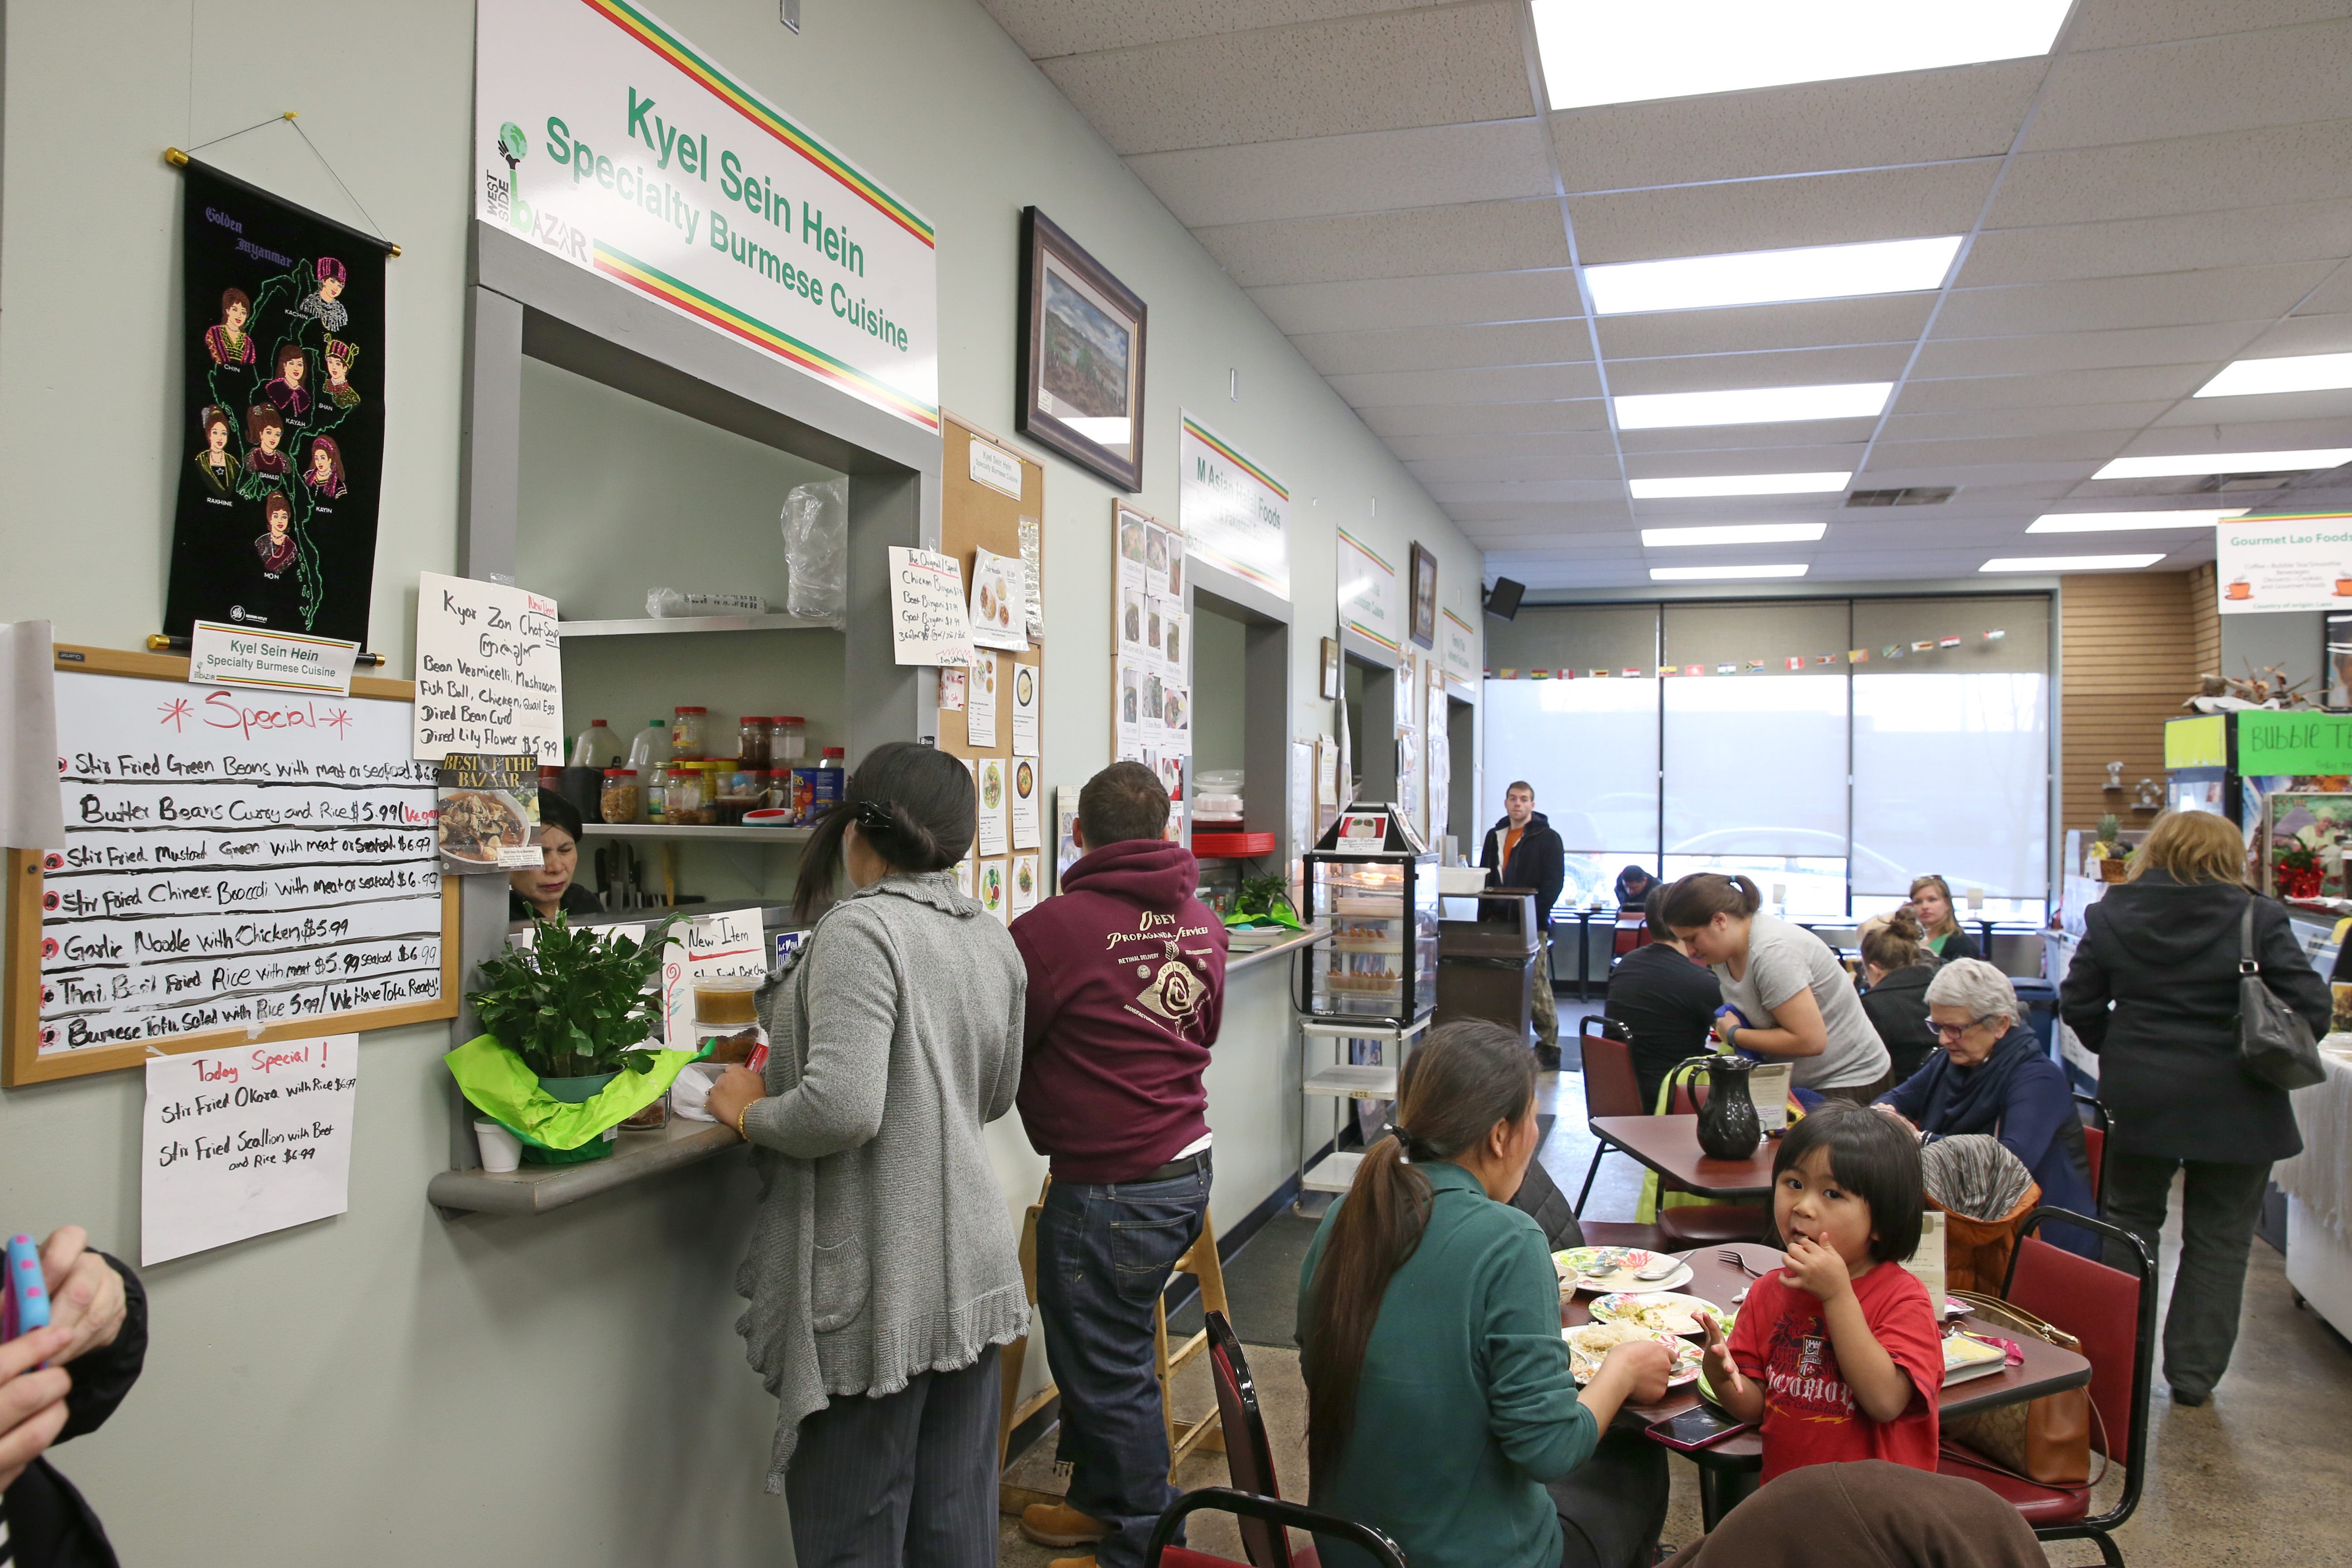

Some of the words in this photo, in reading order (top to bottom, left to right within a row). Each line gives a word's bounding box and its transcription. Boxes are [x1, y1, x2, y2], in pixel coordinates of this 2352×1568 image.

[487, 169, 498, 216] WEST
[628, 86, 707, 183] Kyel
[720, 150, 791, 234] Sein
[803, 202, 864, 278] Hein
[498, 179, 509, 222] SIDE
[206, 206, 242, 233] Golden
[546, 116, 700, 244] Specialty
[710, 210, 823, 306] Burmese
[830, 282, 908, 352] Cuisine
[235, 238, 293, 268] Myanmar
[284, 308, 309, 320] KACHIN
[224, 364, 240, 372] CHIN
[286, 418, 305, 426] KAYAH
[260, 472, 279, 481] BAMAR
[207, 498, 233, 507] RAKHINE
[1197, 456, 1205, 483] M
[1209, 465, 1233, 497] Asian
[1236, 483, 1256, 514] Halal
[1259, 497, 1280, 530] Foods
[2231, 535, 2287, 545] Gourmet
[2290, 534, 2313, 543] Lao
[907, 550, 918, 564] The
[528, 595, 541, 612] New
[541, 600, 555, 617] Item
[922, 595, 944, 612] Biryani
[488, 606, 512, 630] Zan
[519, 614, 543, 637] Chat
[922, 612, 944, 627] Biryani
[207, 654, 254, 670] Specialty
[257, 660, 299, 673] Burmese
[302, 665, 335, 677] Cuisine
[230, 640, 256, 655] Kyel
[261, 644, 286, 657] Sein
[290, 647, 318, 662] Hein
[423, 655, 452, 672] Bean
[516, 672, 557, 694] Mushroom
[421, 680, 443, 696] Fish
[523, 698, 541, 711] Quail
[543, 700, 555, 715] Egg
[204, 691, 316, 740] Special
[421, 706, 456, 722] Dired
[461, 706, 488, 722] Bean
[489, 709, 512, 725] Curd
[421, 728, 456, 744] Dired
[459, 729, 480, 749] Lily
[485, 731, 517, 746] Flower
[521, 735, 558, 758] $5.99
[76, 752, 111, 775] Stir
[118, 754, 160, 775] Fried
[167, 754, 213, 772] Green
[224, 756, 271, 776] Beans
[316, 763, 346, 778] meat
[350, 766, 360, 778] or
[443, 755, 480, 770] BEST
[502, 757, 537, 771] THE
[80, 794, 149, 823] Butter
[159, 796, 223, 821] Beans
[285, 801, 312, 818] and
[320, 802, 348, 818] Rice
[68, 846, 102, 867] Stir
[107, 847, 147, 866] Fried
[219, 842, 260, 856] Green
[307, 837, 338, 851] meat
[399, 835, 431, 853] $6.99
[62, 890, 98, 916] Stir
[103, 888, 142, 914] Fried
[397, 869, 439, 890] $6.99
[689, 929, 714, 948] New
[717, 917, 749, 945] Item
[1139, 911, 1176, 931] OBEY
[64, 934, 122, 960] Garlic
[135, 929, 190, 954] Noodle
[235, 923, 300, 946] Chicken
[301, 918, 348, 943] $5.99
[212, 967, 251, 990] Rice
[315, 952, 359, 975] $5.99
[398, 945, 436, 965] $6.99
[1118, 956, 1140, 965] RETINAL
[1158, 965, 1171, 985] PROP
[142, 1016, 179, 1037] Tofu
[256, 998, 284, 1022] Rice
[192, 1059, 239, 1083] Today
[252, 1046, 309, 1074] Special
[162, 1102, 191, 1123] Stir
[195, 1093, 230, 1116] Fried
[313, 1078, 333, 1091] Rice
[335, 1078, 356, 1092] $6.99
[160, 1142, 188, 1166] Stir
[195, 1136, 230, 1161] Fried
[238, 1127, 284, 1152] Scallion
[229, 1156, 248, 1171] and
[254, 1155, 276, 1167] Rice
[282, 1148, 315, 1164] $6.99
